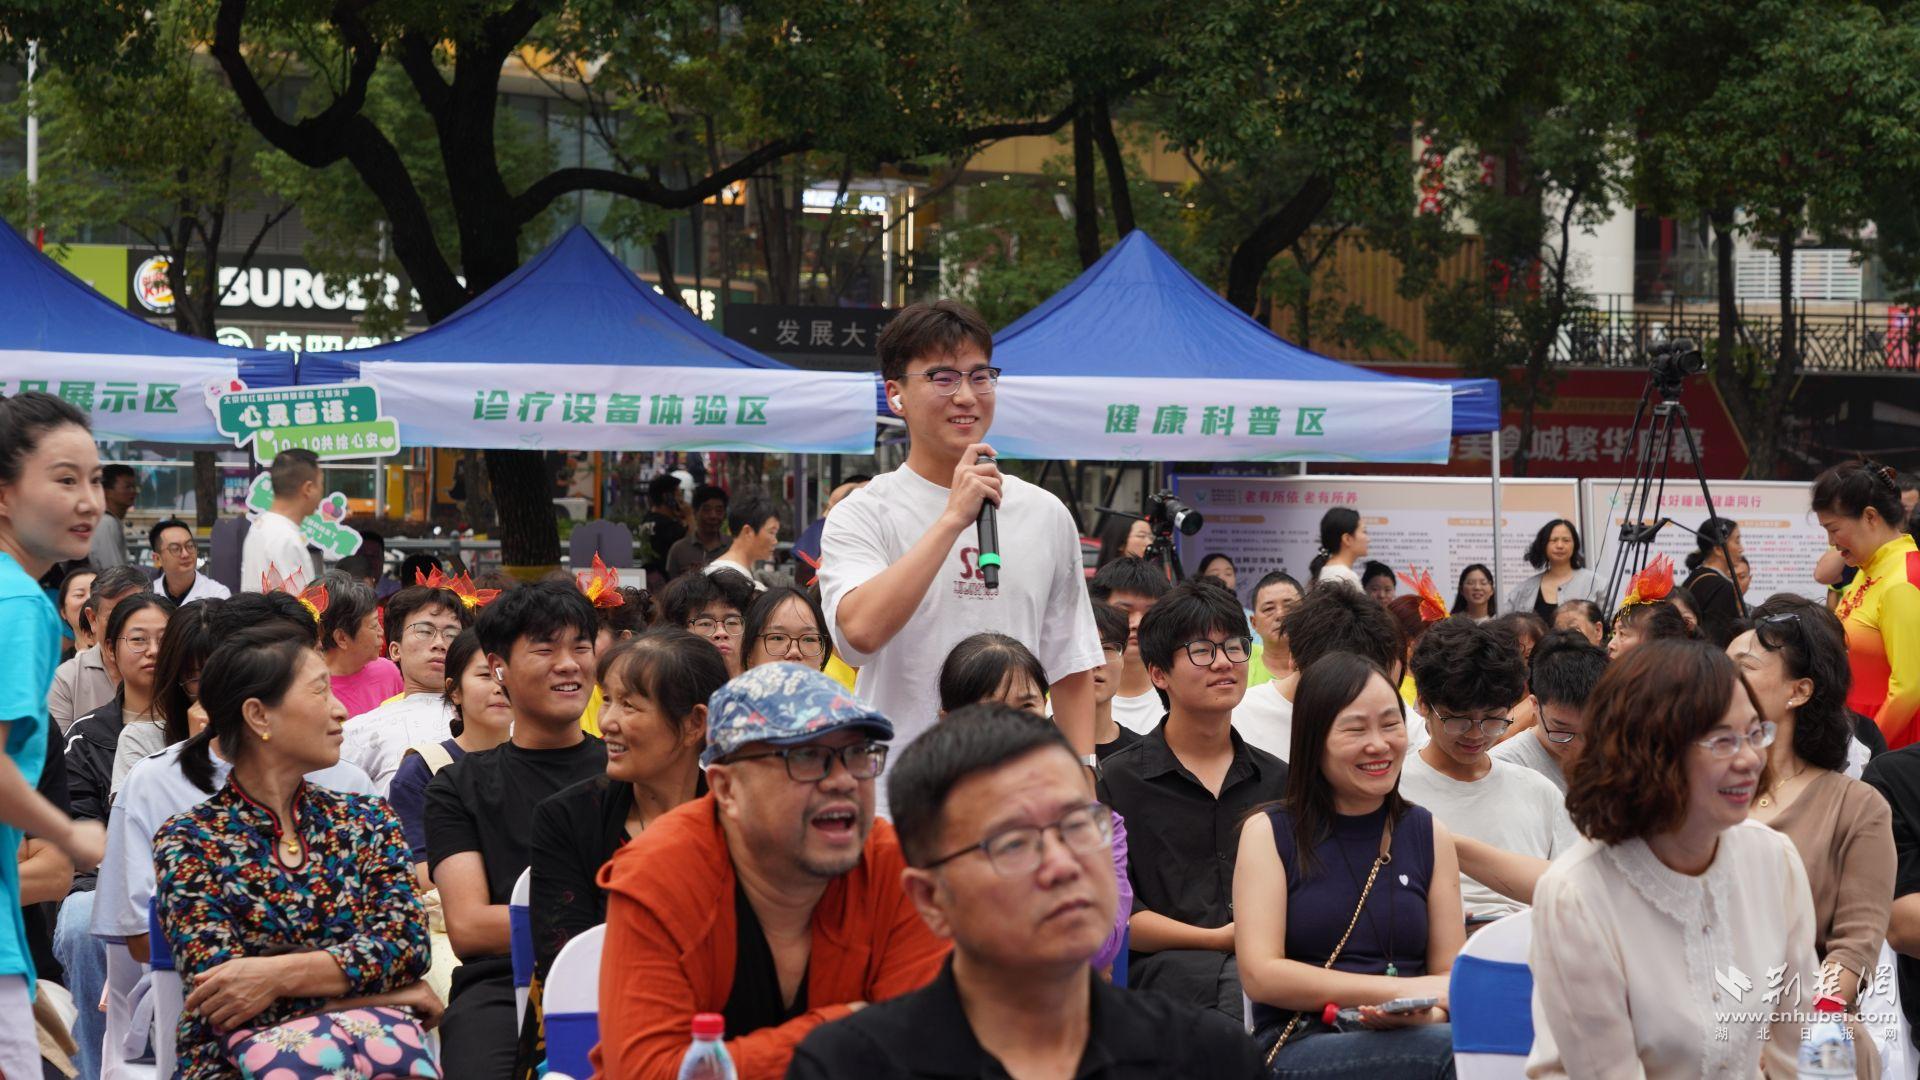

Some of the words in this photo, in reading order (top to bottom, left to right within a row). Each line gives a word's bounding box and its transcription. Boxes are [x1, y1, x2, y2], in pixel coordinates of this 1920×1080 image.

[776, 319, 884, 348] 发展大
[473, 390, 770, 426] 诊疗设备体验区
[1104, 404, 1327, 437] 健康科普区
